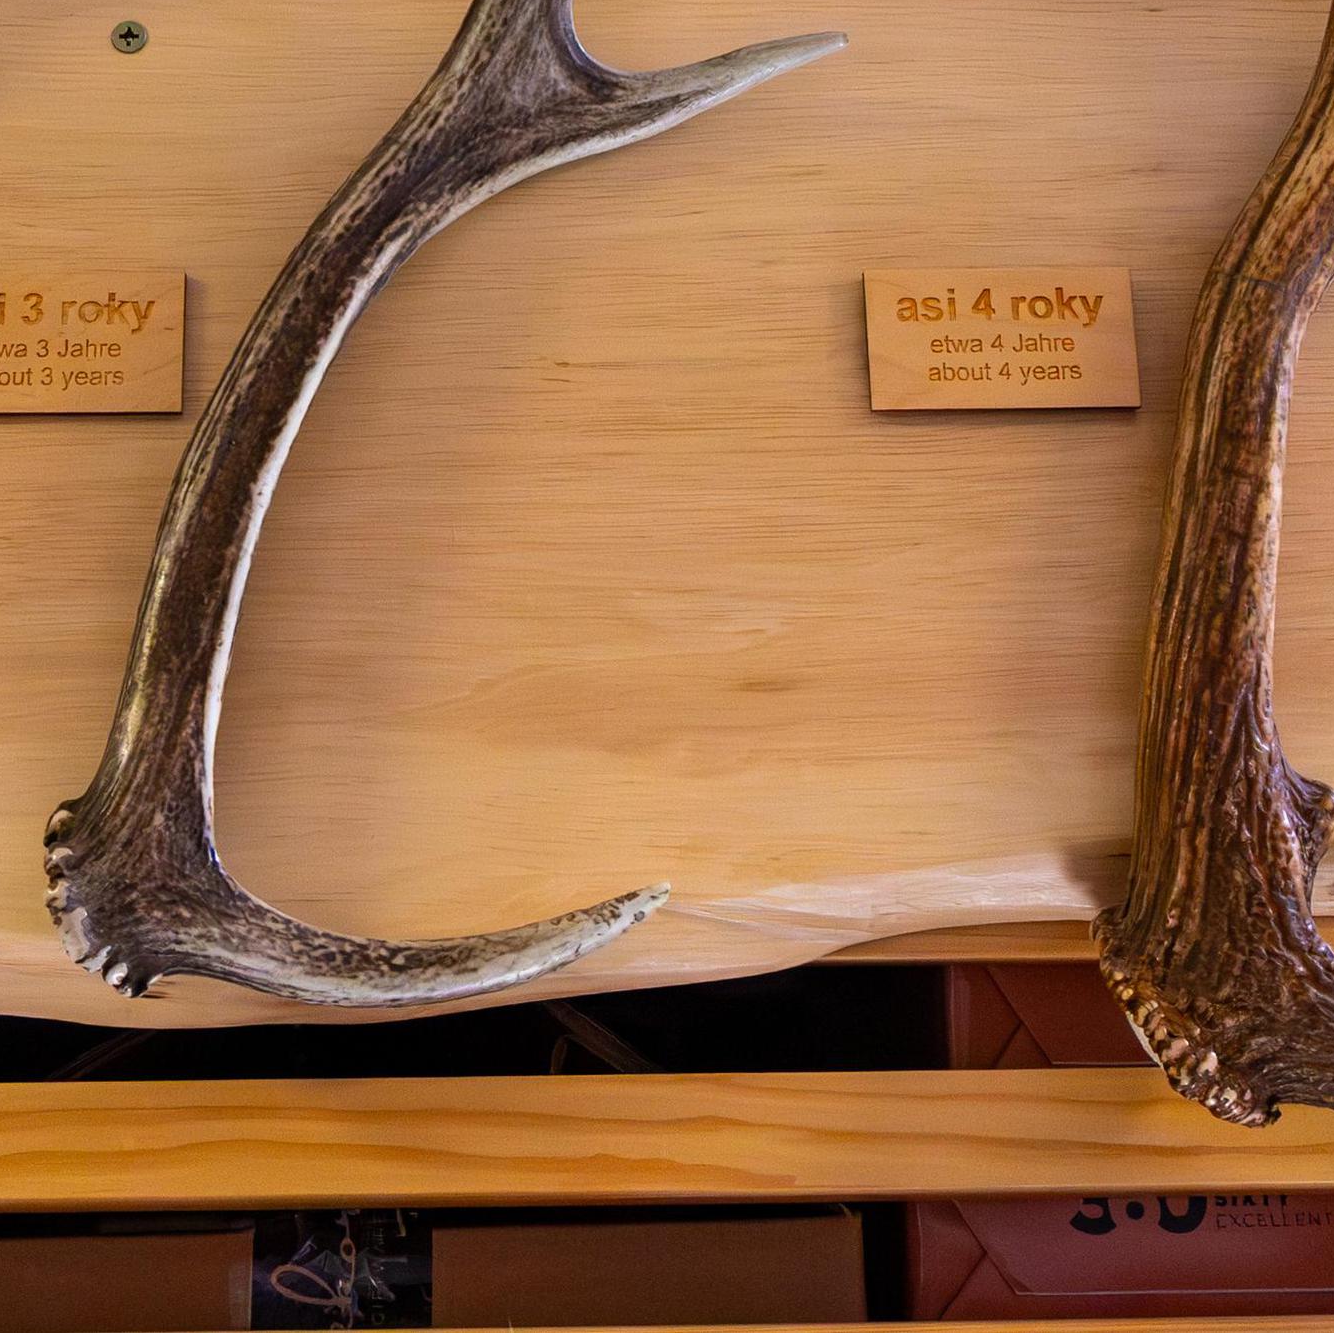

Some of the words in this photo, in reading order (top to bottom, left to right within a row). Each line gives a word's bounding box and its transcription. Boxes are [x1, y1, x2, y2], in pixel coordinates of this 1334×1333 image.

[21, 292, 44, 325] 3
[60, 292, 156, 334] roky
[896, 288, 957, 322] asi
[971, 288, 995, 320] 4
[1011, 287, 1103, 327] roky
[36, 339, 49, 358] 3
[57, 339, 122, 358] Jahre
[930, 334, 983, 353] etwa
[990, 334, 1004, 352] 4
[1012, 333, 1075, 353] Jahre
[40, 367, 53, 386] 3
[62, 369, 124, 391] years
[928, 362, 992, 381] about
[998, 362, 1012, 380] 4
[1019, 363, 1082, 386] years
[1216, 1211, 1333, 1228] EXCELLENT
